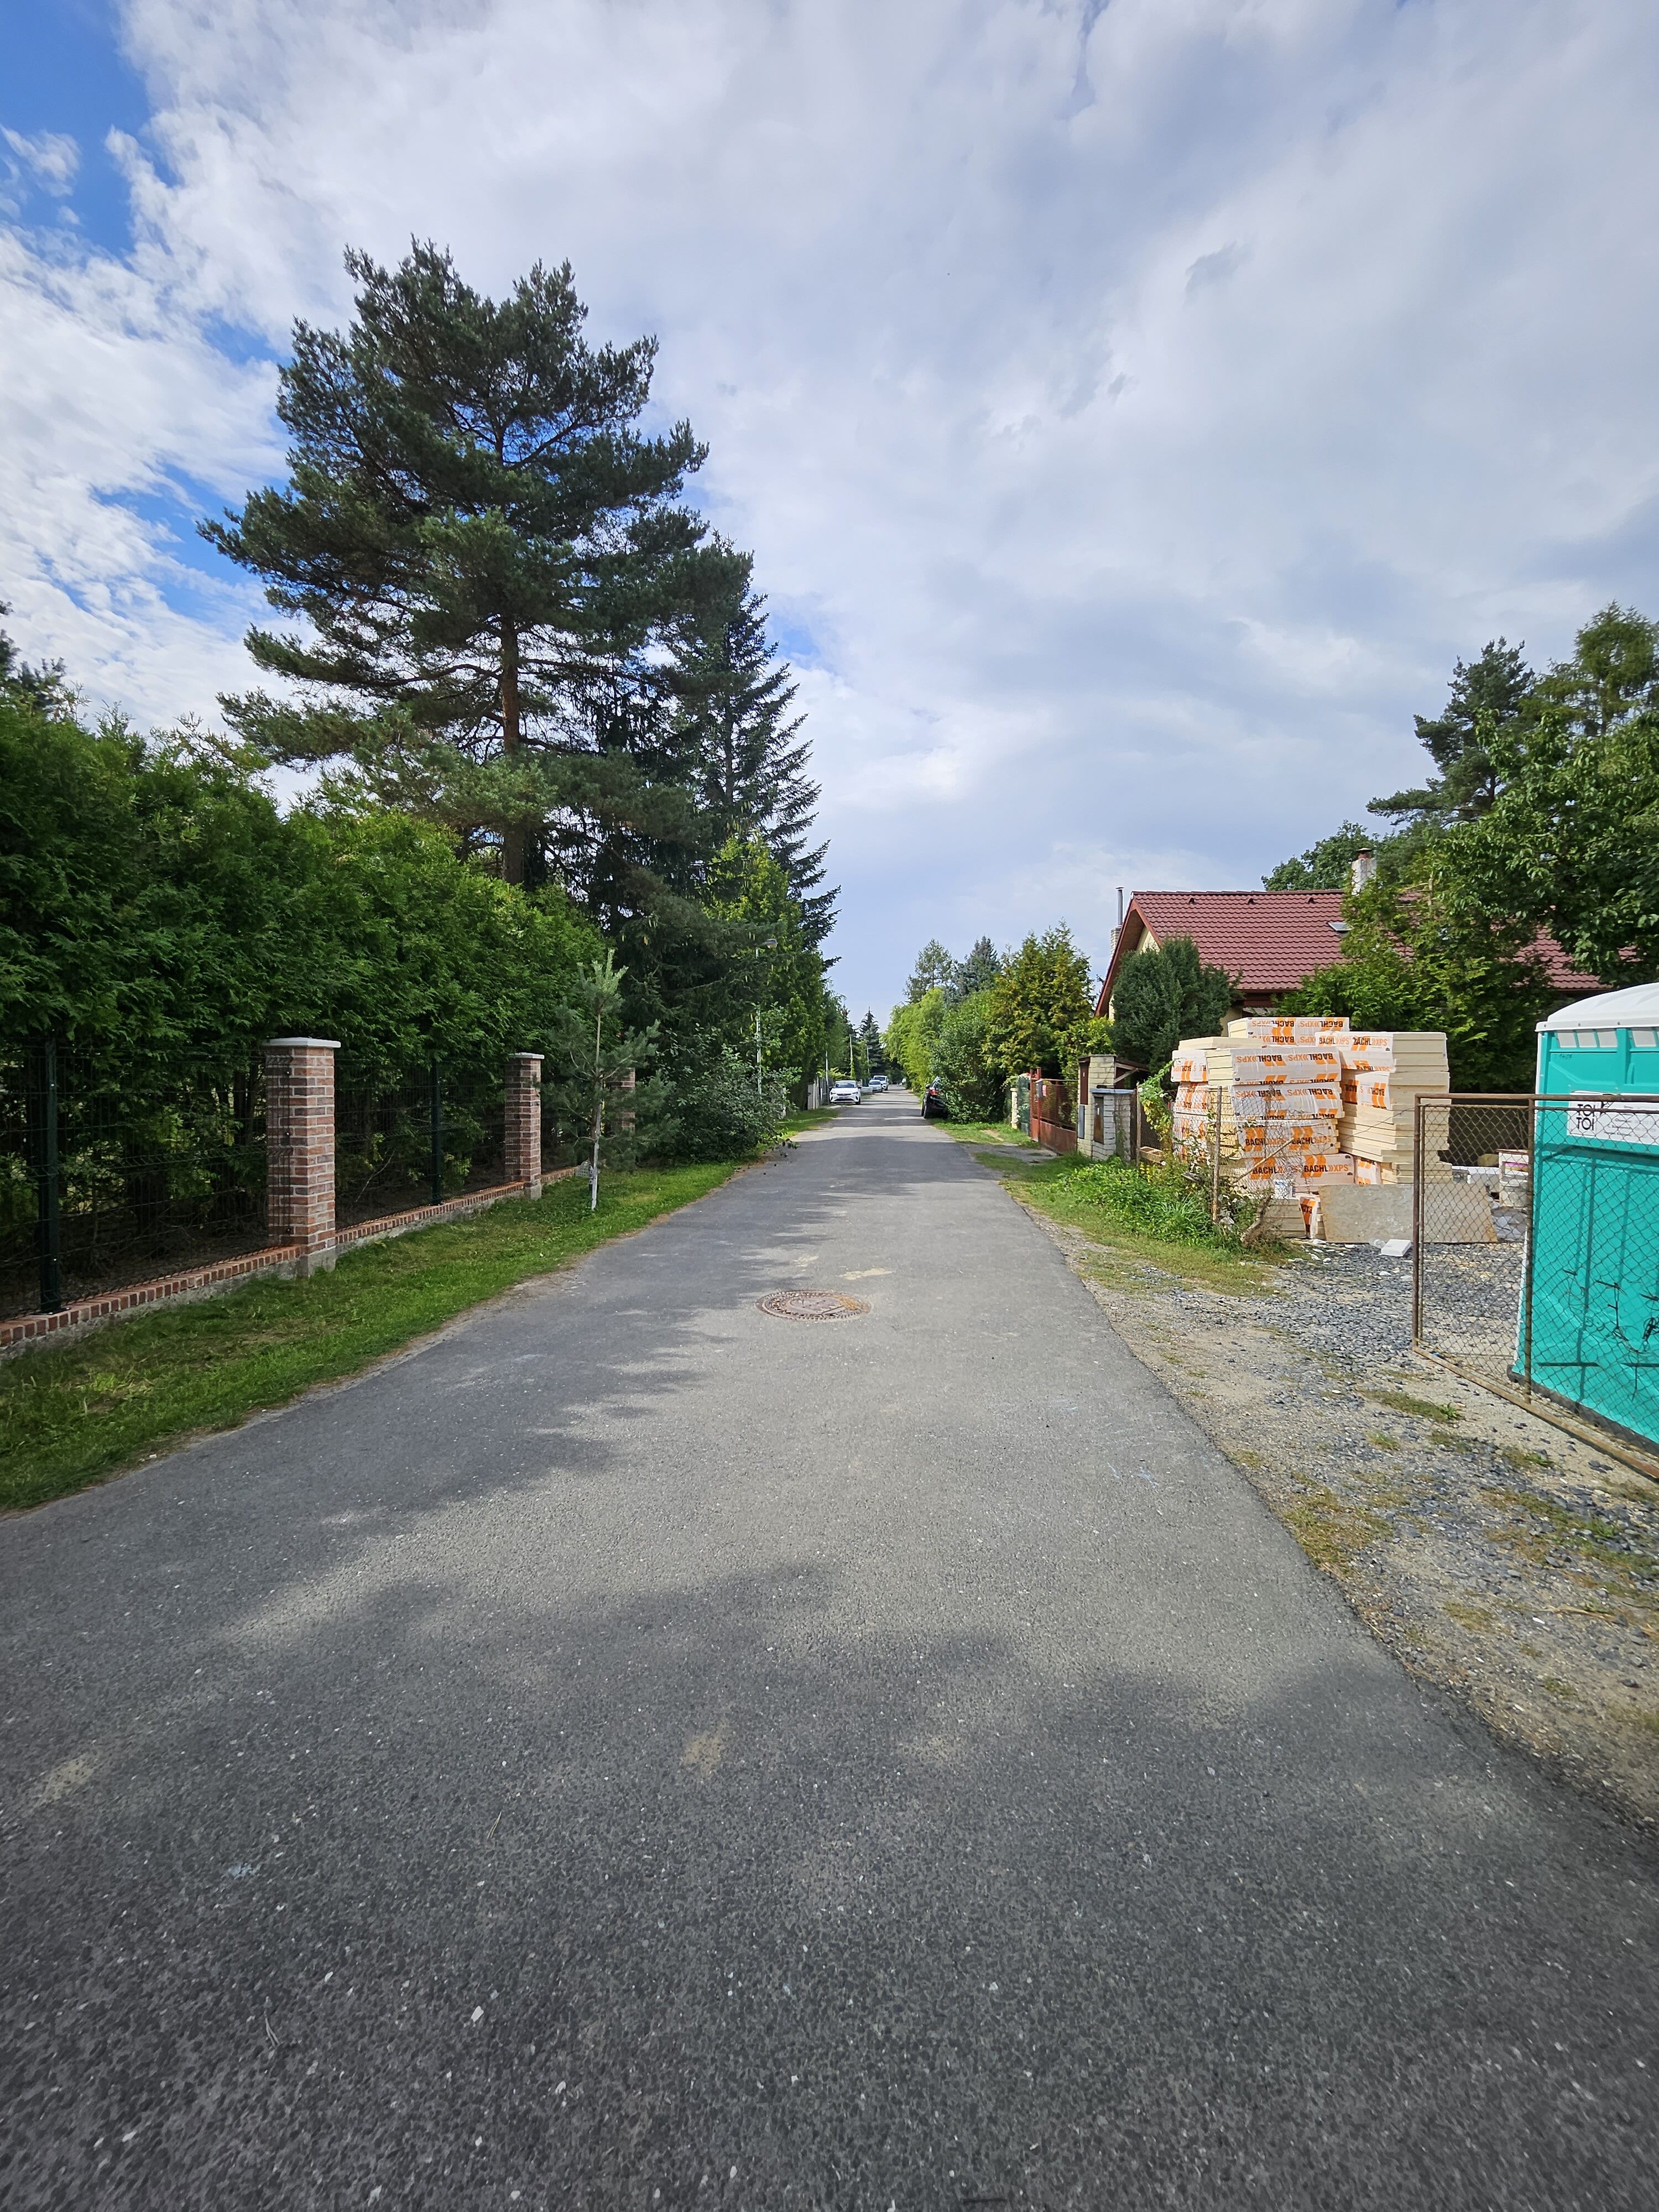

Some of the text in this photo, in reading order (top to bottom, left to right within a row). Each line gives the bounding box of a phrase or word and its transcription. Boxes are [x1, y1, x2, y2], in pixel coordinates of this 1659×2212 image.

[1353, 1037, 1388, 1046] BACHL XPS
[1577, 1103, 1595, 1117] TOI
[1576, 1117, 1594, 1131] TOI
[1303, 1164, 1328, 1172] BACHL
[1334, 1164, 1349, 1172] XPS
